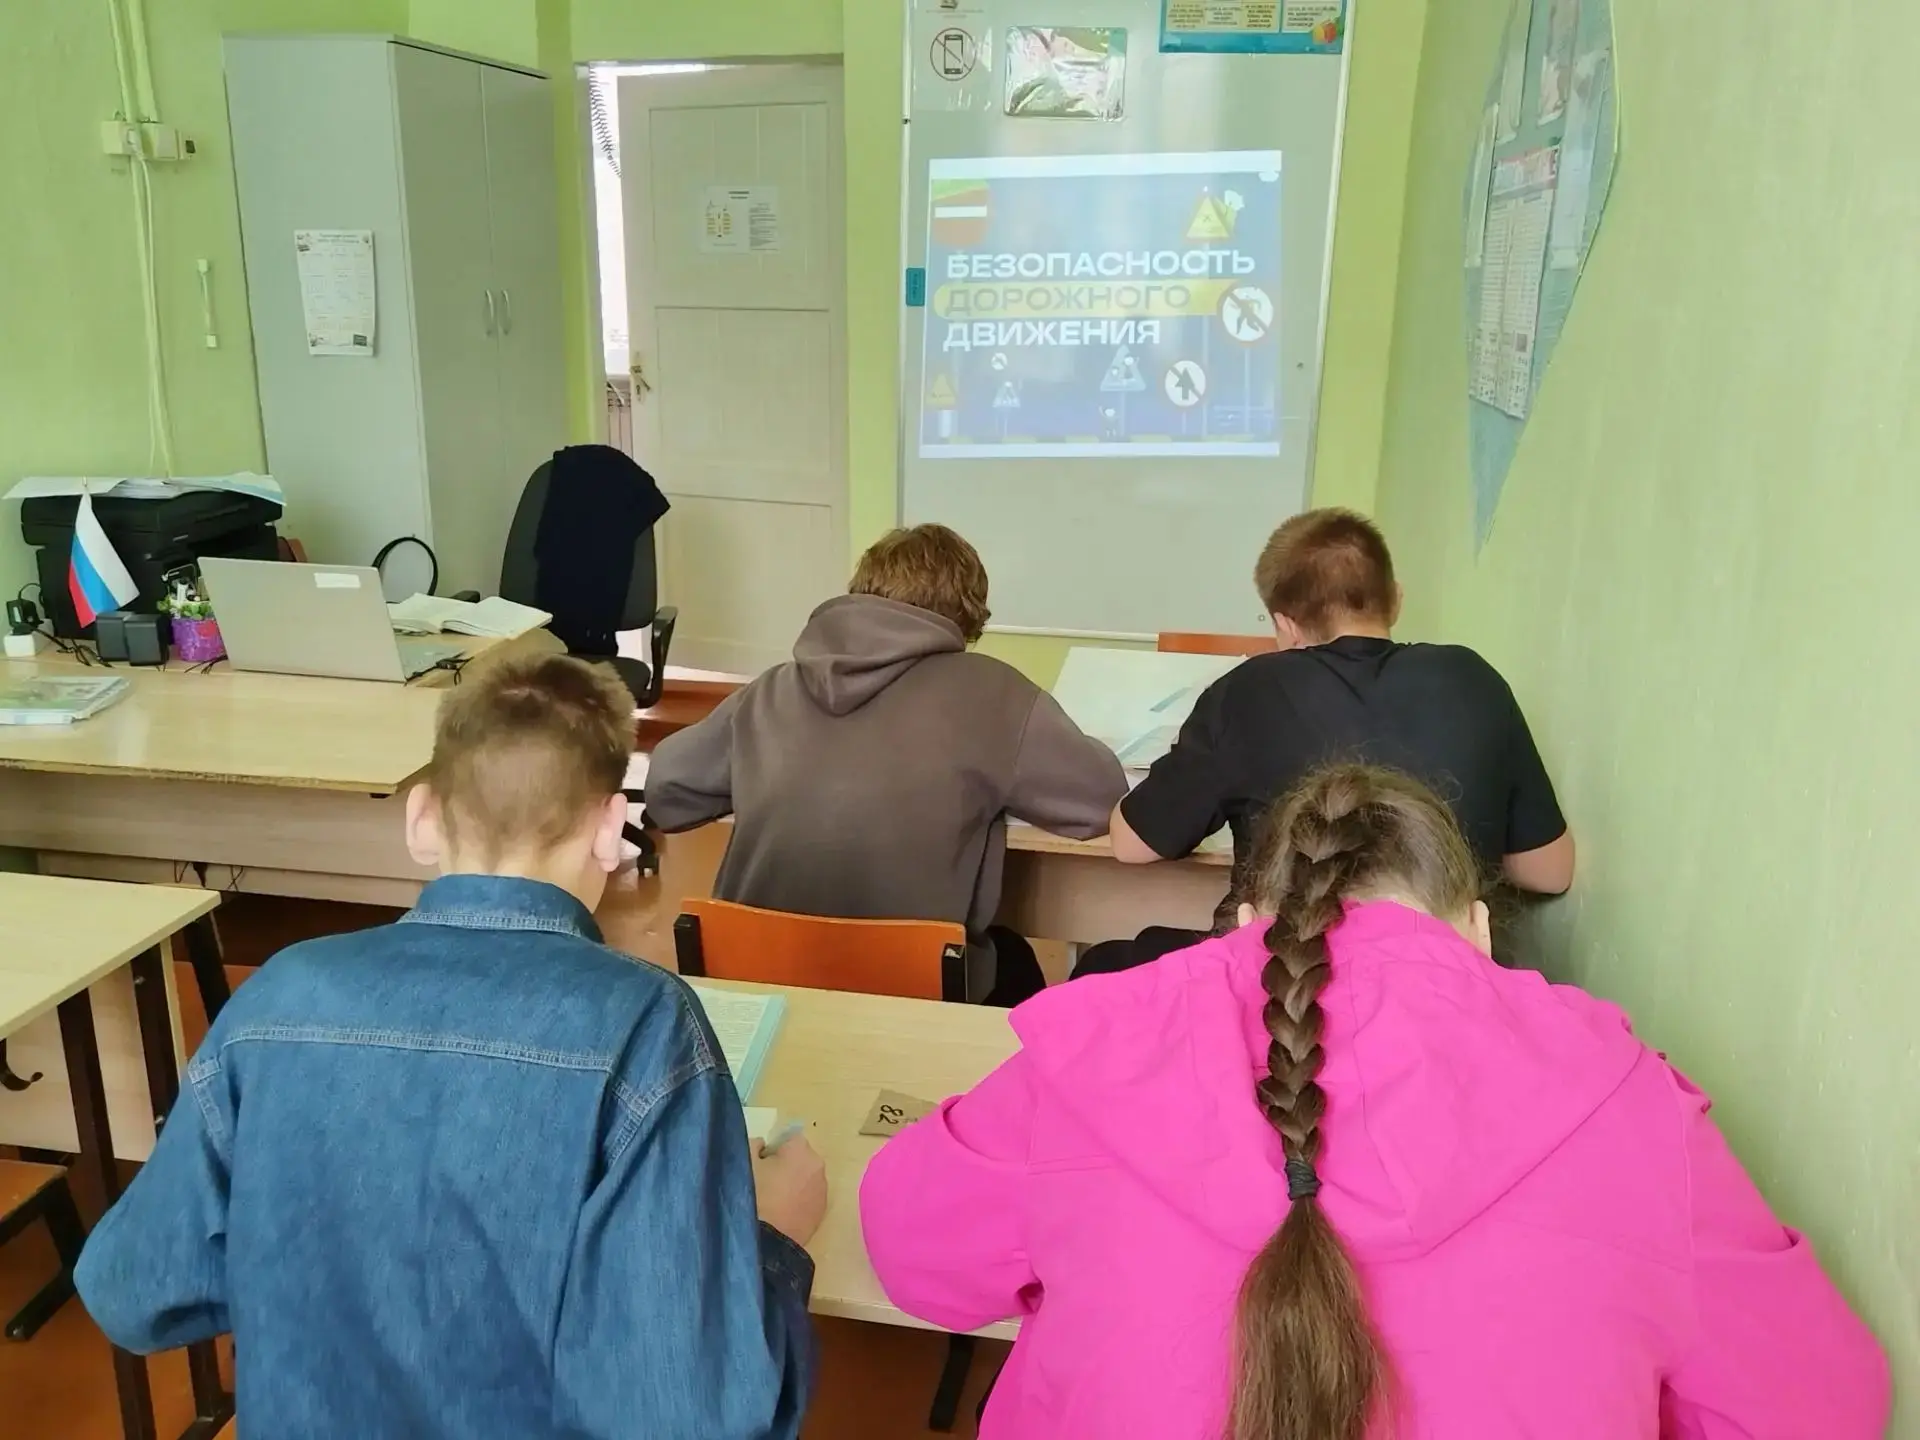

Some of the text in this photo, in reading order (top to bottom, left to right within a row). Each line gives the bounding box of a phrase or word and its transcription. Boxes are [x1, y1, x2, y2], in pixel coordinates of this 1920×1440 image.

[948, 250, 1255, 278] БЕЗОПАСНОСТЬ
[945, 285, 1191, 316] ДОРОЖНОГО
[943, 320, 1160, 351] ДВИЖЕНИЯ
